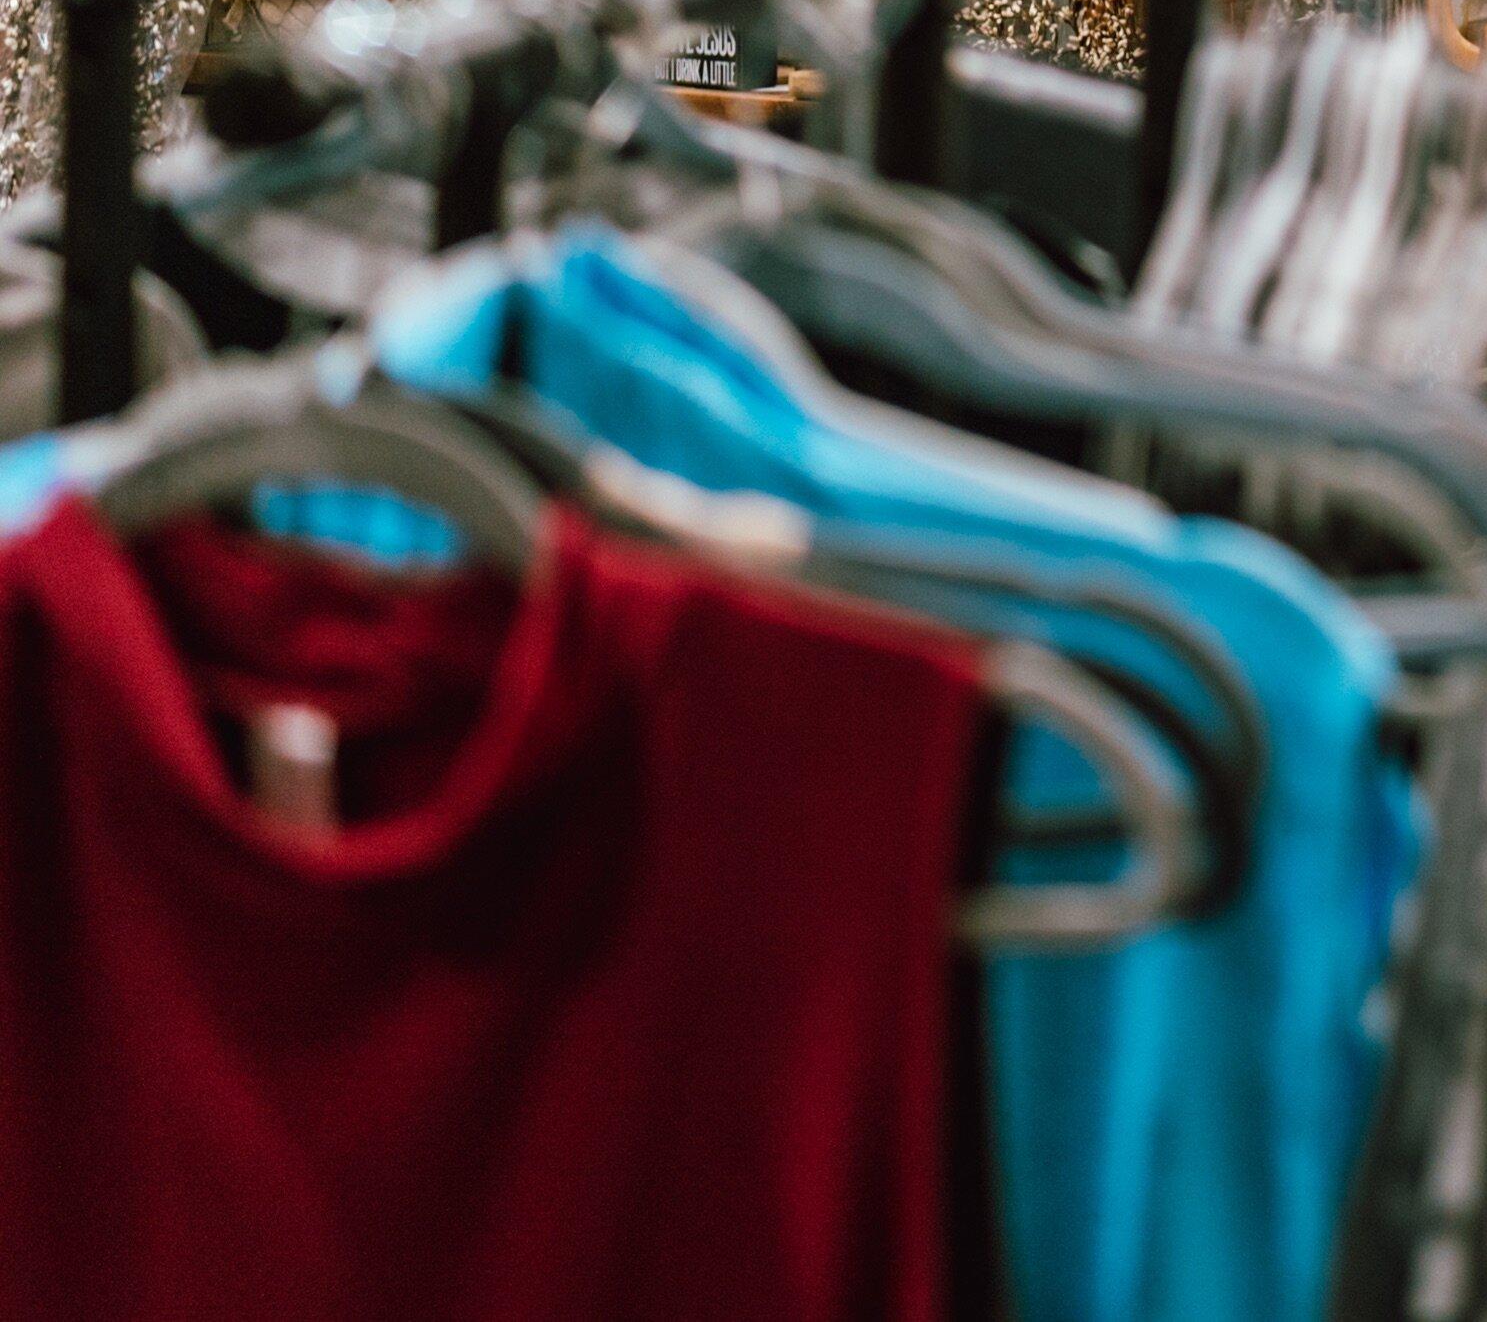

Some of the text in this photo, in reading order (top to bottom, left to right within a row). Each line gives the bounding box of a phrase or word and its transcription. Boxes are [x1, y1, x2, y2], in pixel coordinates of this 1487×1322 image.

[675, 58, 701, 84] DRINK
[701, 60, 709, 85] A
[710, 61, 737, 87] LITTLE
